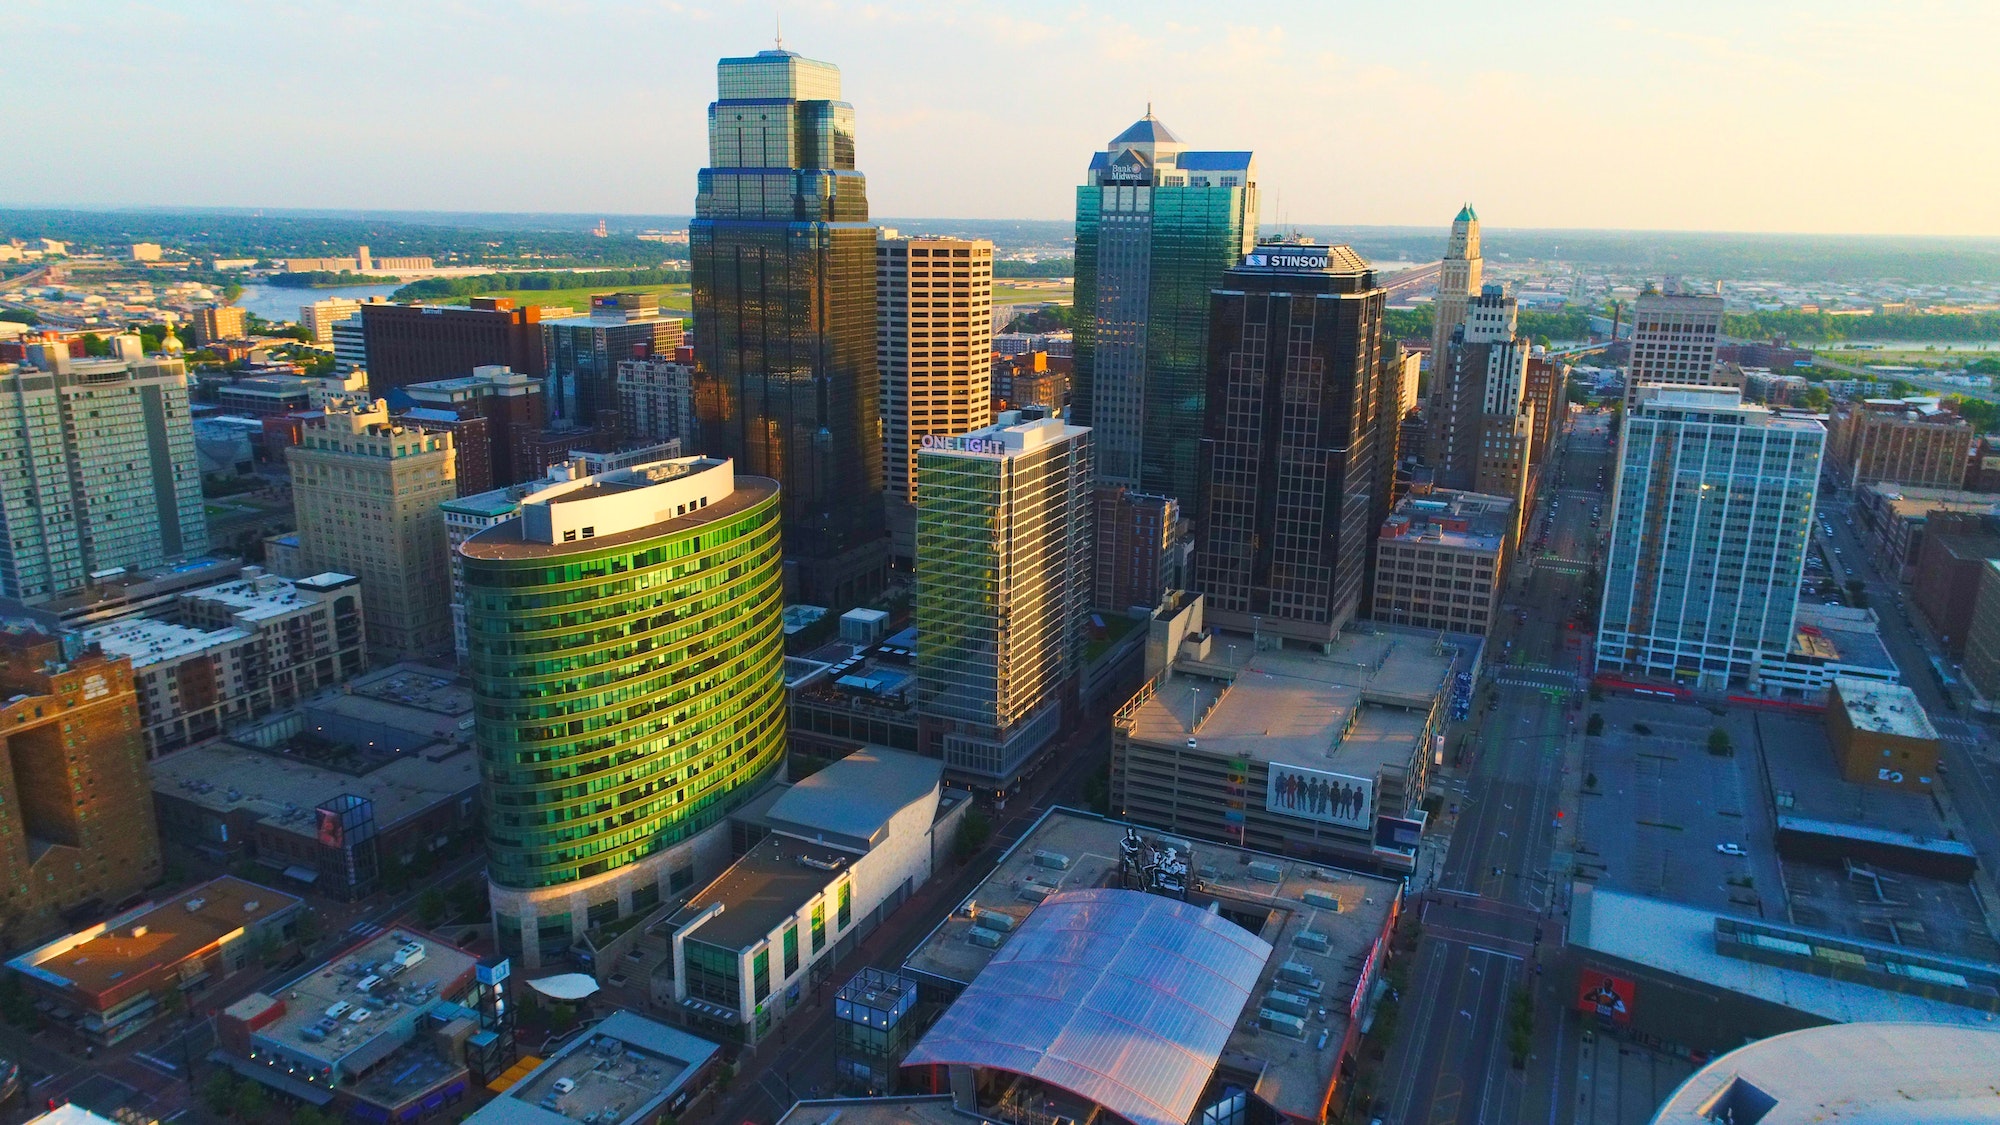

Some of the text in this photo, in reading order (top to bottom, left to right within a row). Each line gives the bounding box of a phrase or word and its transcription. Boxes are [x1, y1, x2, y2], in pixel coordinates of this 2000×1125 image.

[1112, 164, 1132, 173] Bank
[1112, 172, 1142, 180] Midwest
[1271, 255, 1328, 268] STINSON
[921, 434, 1003, 454] ONE LIGHT
